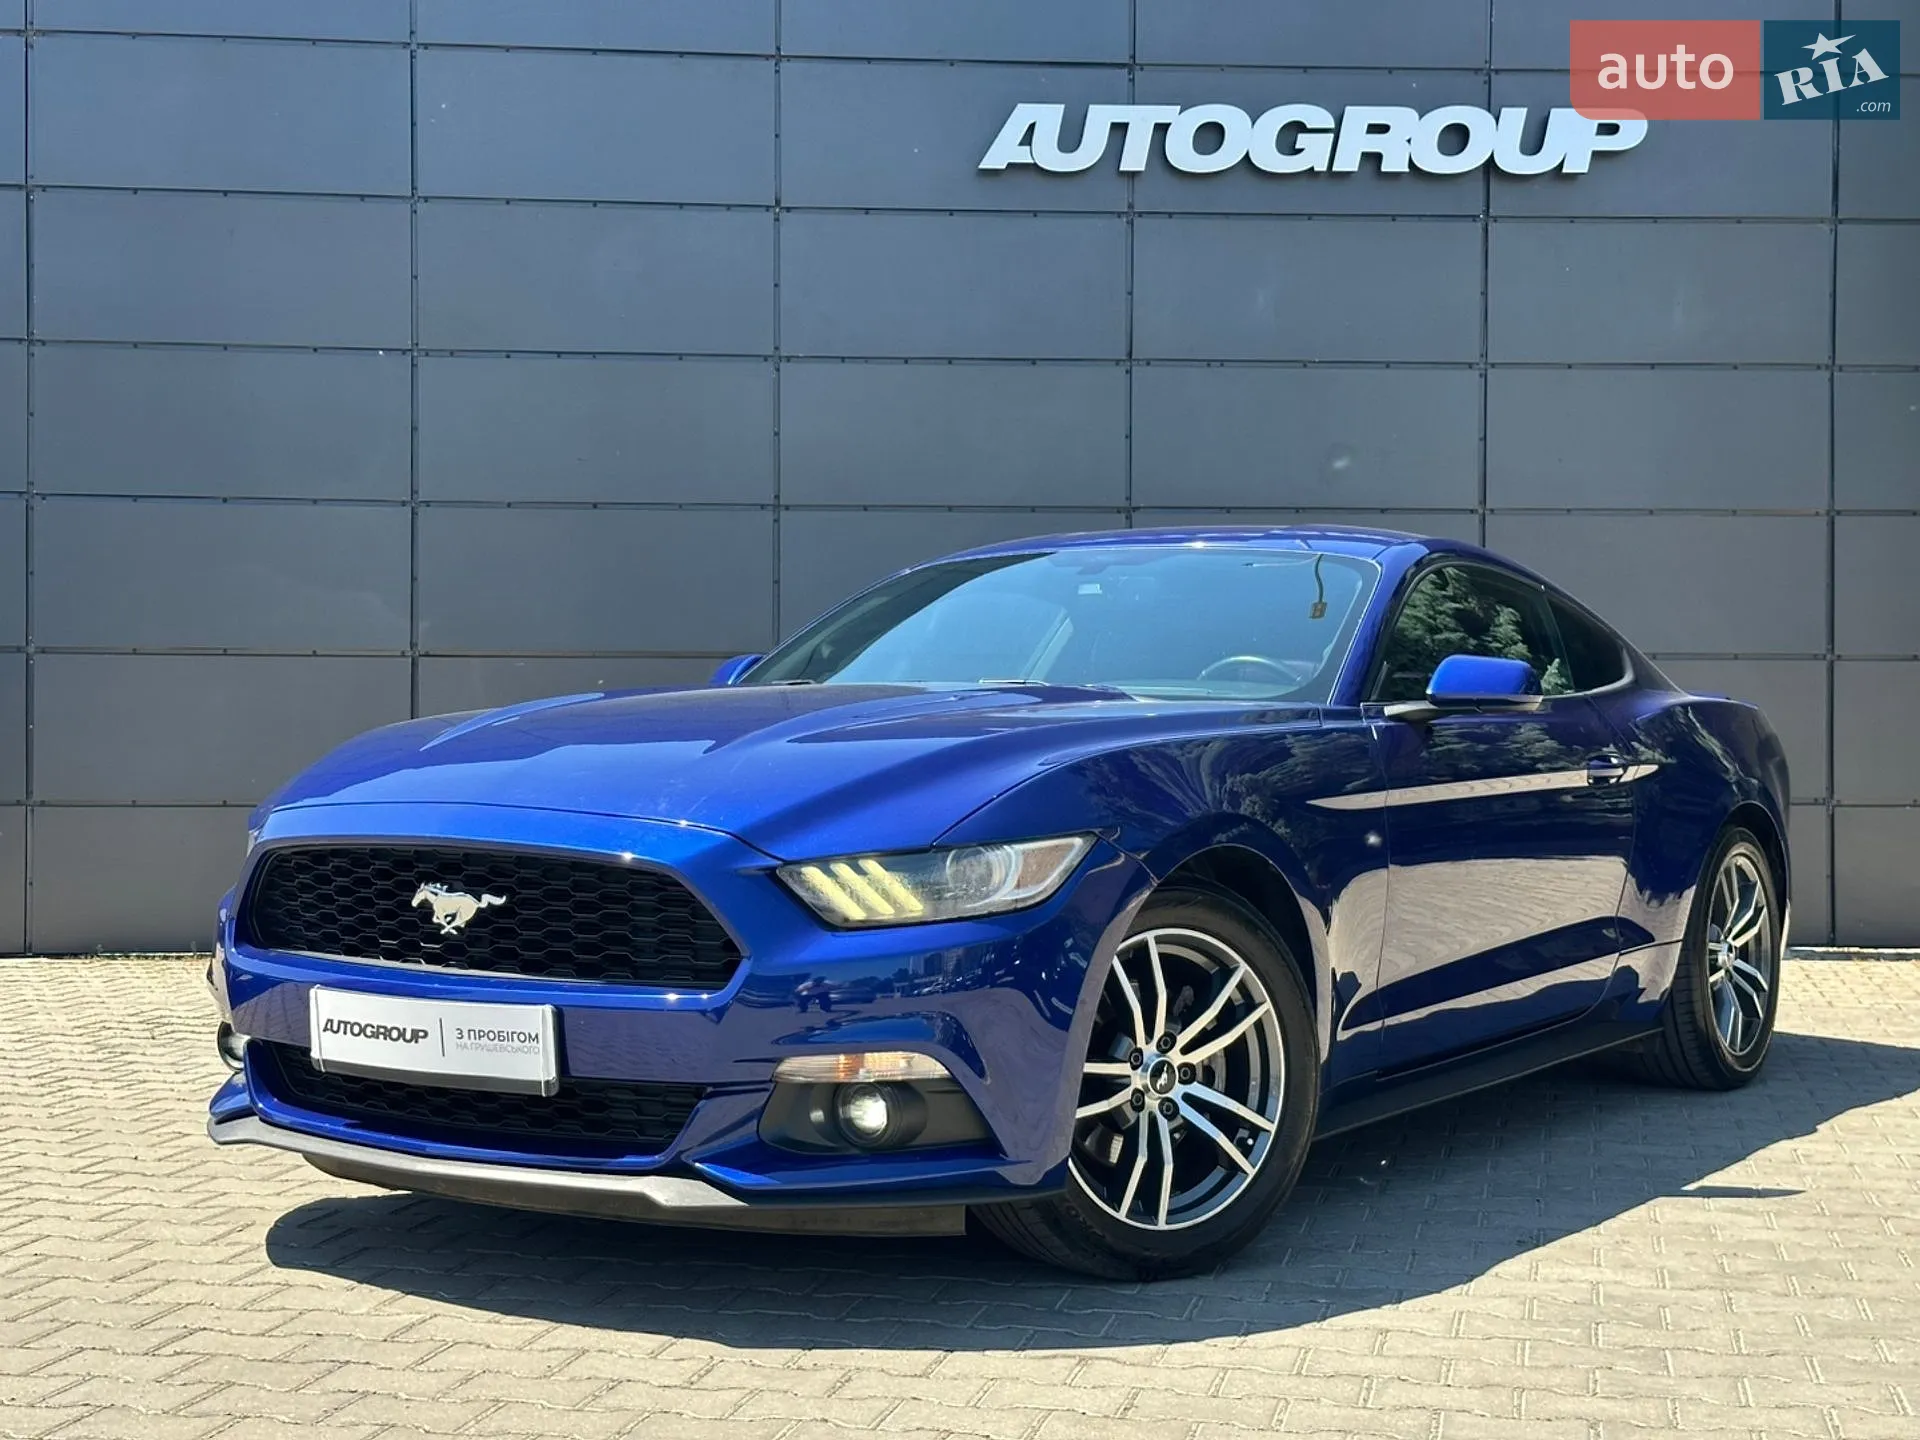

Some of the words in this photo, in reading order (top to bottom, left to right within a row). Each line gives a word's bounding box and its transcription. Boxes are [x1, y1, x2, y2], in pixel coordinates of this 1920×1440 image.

[978, 102, 1649, 175] AUTOGROUP
[322, 1018, 429, 1044] AUTOGROUP
[455, 1027, 464, 1040] З
[467, 1029, 540, 1045] ПРОБІГОМ
